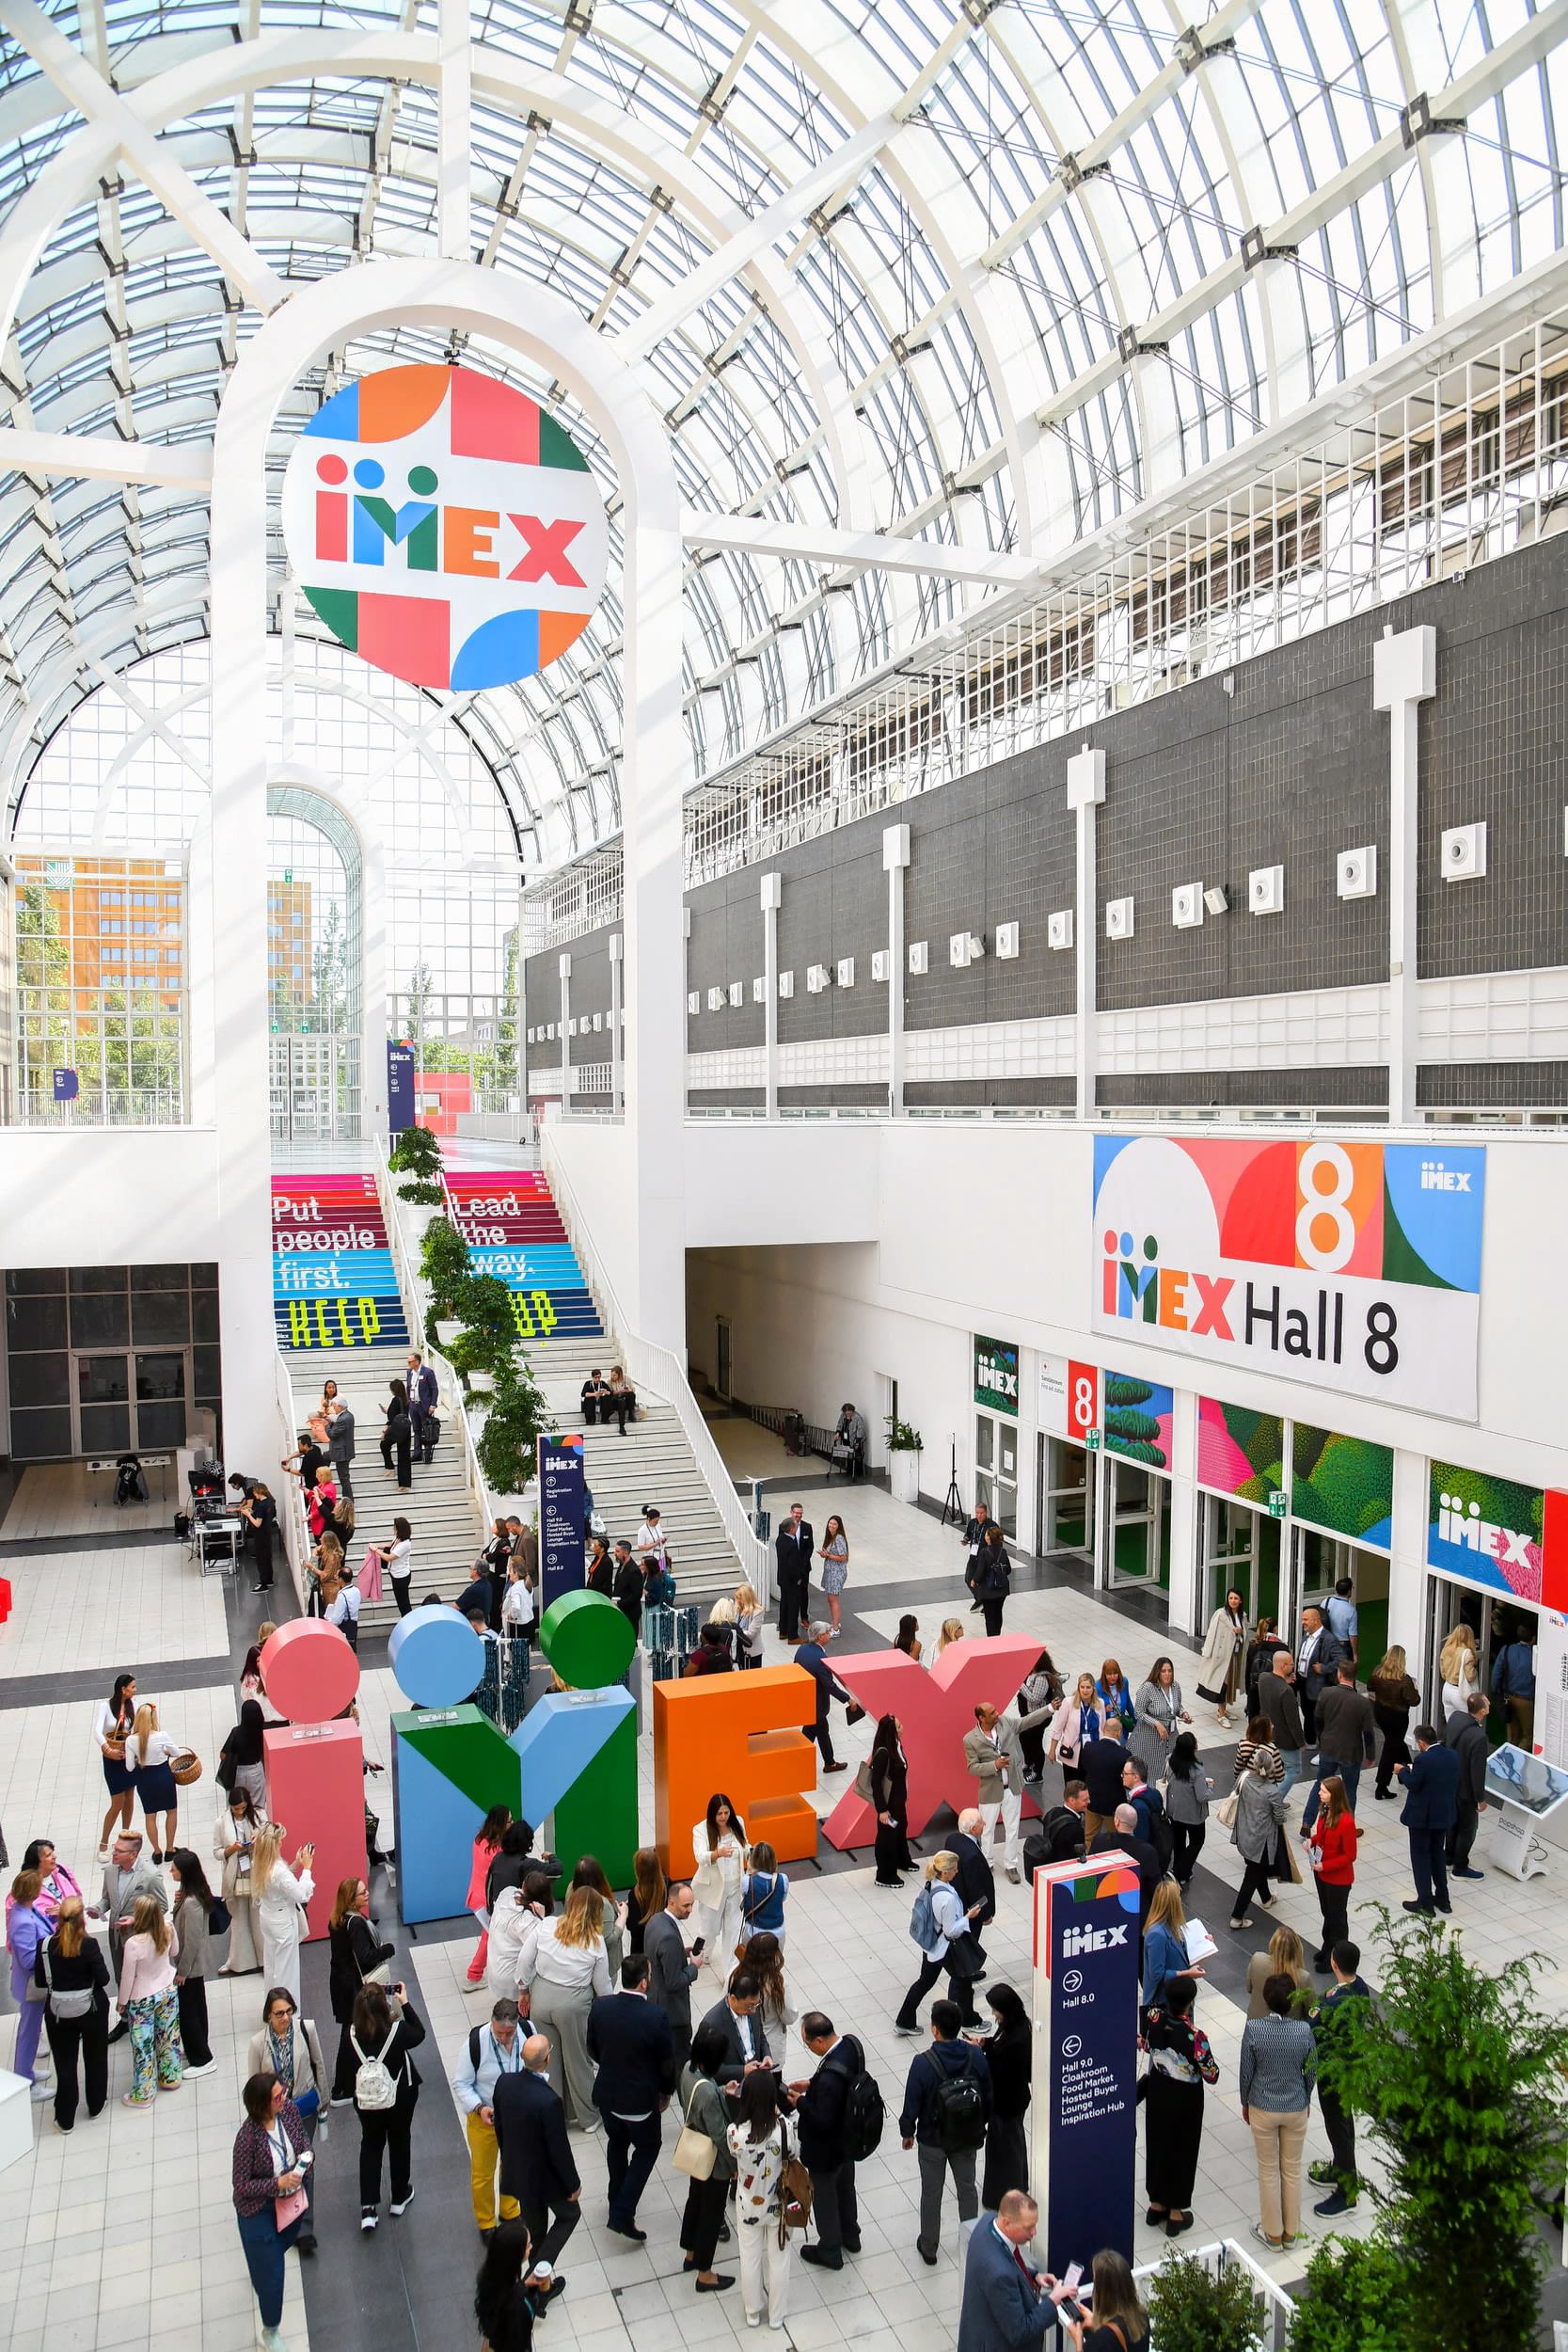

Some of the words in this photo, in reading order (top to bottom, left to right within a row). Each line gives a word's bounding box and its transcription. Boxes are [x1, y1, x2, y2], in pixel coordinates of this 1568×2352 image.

[273, 1196, 323, 1222] Put
[451, 1191, 521, 1217] Lead
[1295, 1142, 1355, 1273] 8
[277, 1223, 376, 1259] people
[459, 1220, 507, 1246] the
[279, 1261, 350, 1289] first.
[470, 1254, 534, 1280] way.
[289, 1297, 381, 1347] KEEP
[1244, 1281, 1343, 1365] Hall
[1364, 1301, 1400, 1375] 8
[1074, 1377, 1093, 1426] 8
[1063, 1995, 1080, 2010] Hall
[1081, 1993, 1095, 2004] 8.0
[1061, 2065, 1108, 2084] Cloakroom
[1062, 2060, 1079, 2074] Hall
[1080, 2058, 1093, 2069] 9.0
[1061, 2080, 1084, 2095] Food
[1085, 2074, 1115, 2089] Market
[1061, 2089, 1093, 2106] Hosted
[1094, 2084, 1118, 2097] Buyer
[1061, 2101, 1093, 2115] Lounge
[1061, 2107, 1106, 2126] Inspiration
[1107, 2100, 1125, 2113] Hub
